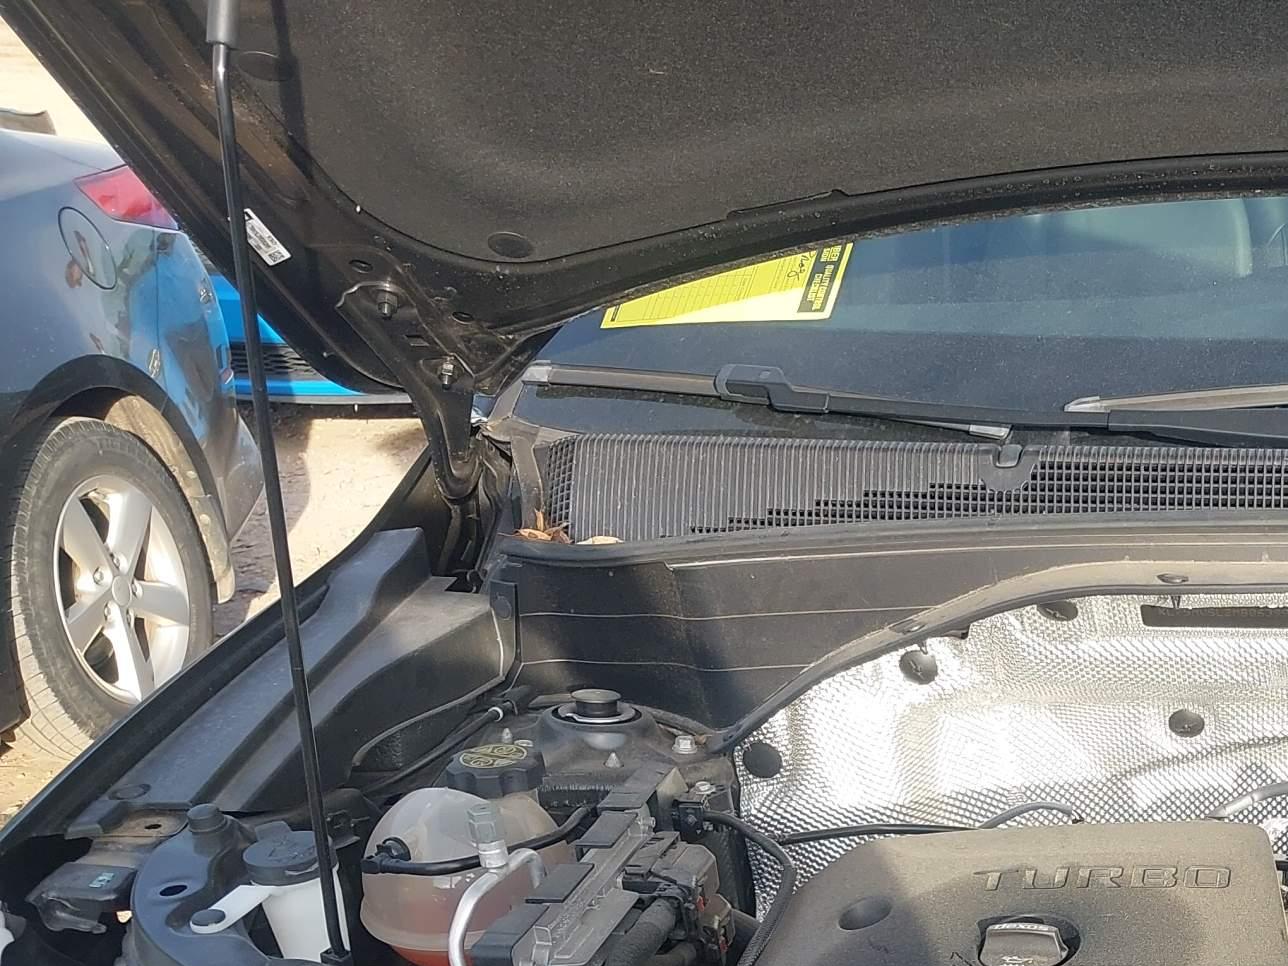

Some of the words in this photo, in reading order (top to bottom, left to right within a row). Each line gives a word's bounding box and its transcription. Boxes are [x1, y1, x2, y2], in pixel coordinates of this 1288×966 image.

[807, 274, 821, 301] CHECKLIST
[821, 265, 834, 286] QUALITY
[812, 286, 827, 310] CONTROL
[973, 864, 1232, 892] TURBO
